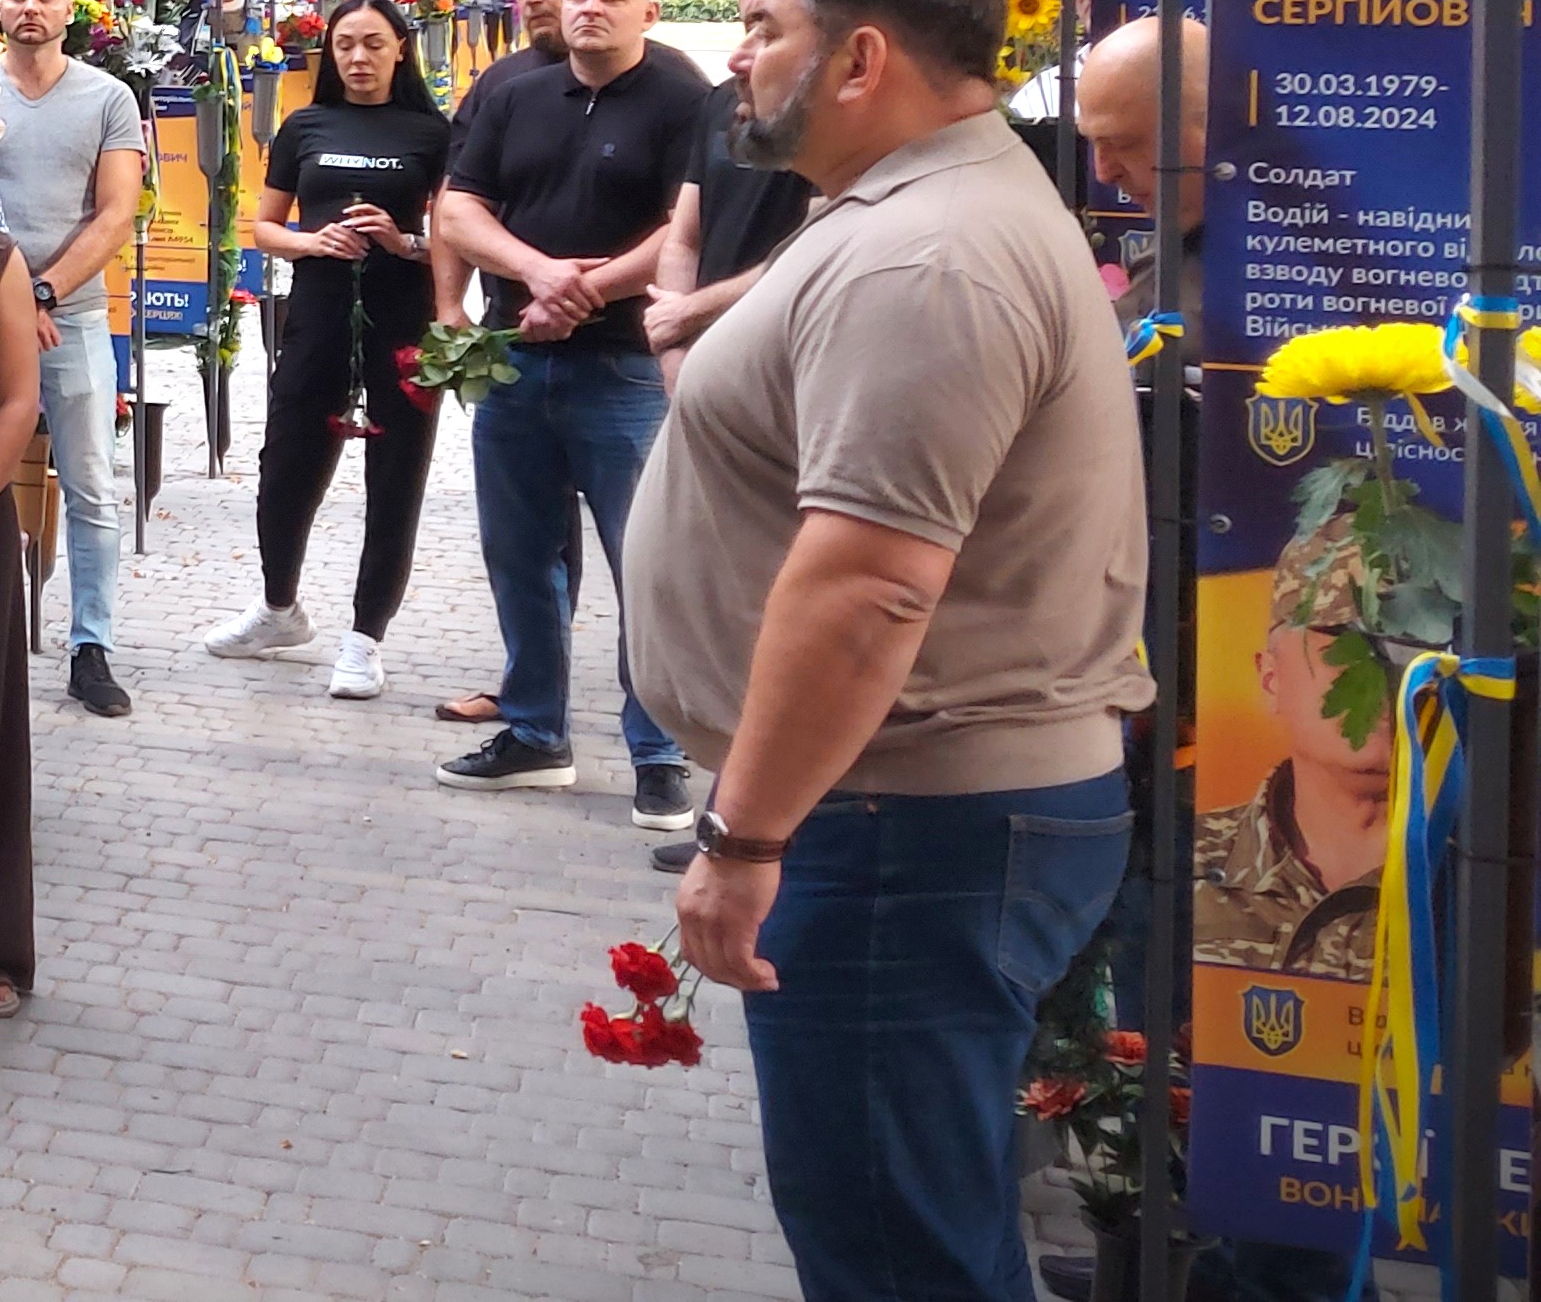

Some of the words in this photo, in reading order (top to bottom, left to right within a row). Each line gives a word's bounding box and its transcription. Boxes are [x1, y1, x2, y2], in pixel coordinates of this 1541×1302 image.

[1275, 72, 1449, 97] 30.03.1979-
[1276, 105, 1437, 129] 12.08.2024
[1248, 162, 1357, 189] Солдат
[1247, 200, 1328, 227] Водій
[1357, 206, 1471, 232] навідни
[1246, 234, 1435, 258] кулеметного
[1245, 263, 1344, 286] взводу
[1352, 269, 1468, 288] вогнево
[1245, 293, 1314, 311] роти
[1322, 295, 1448, 317] вогневої
